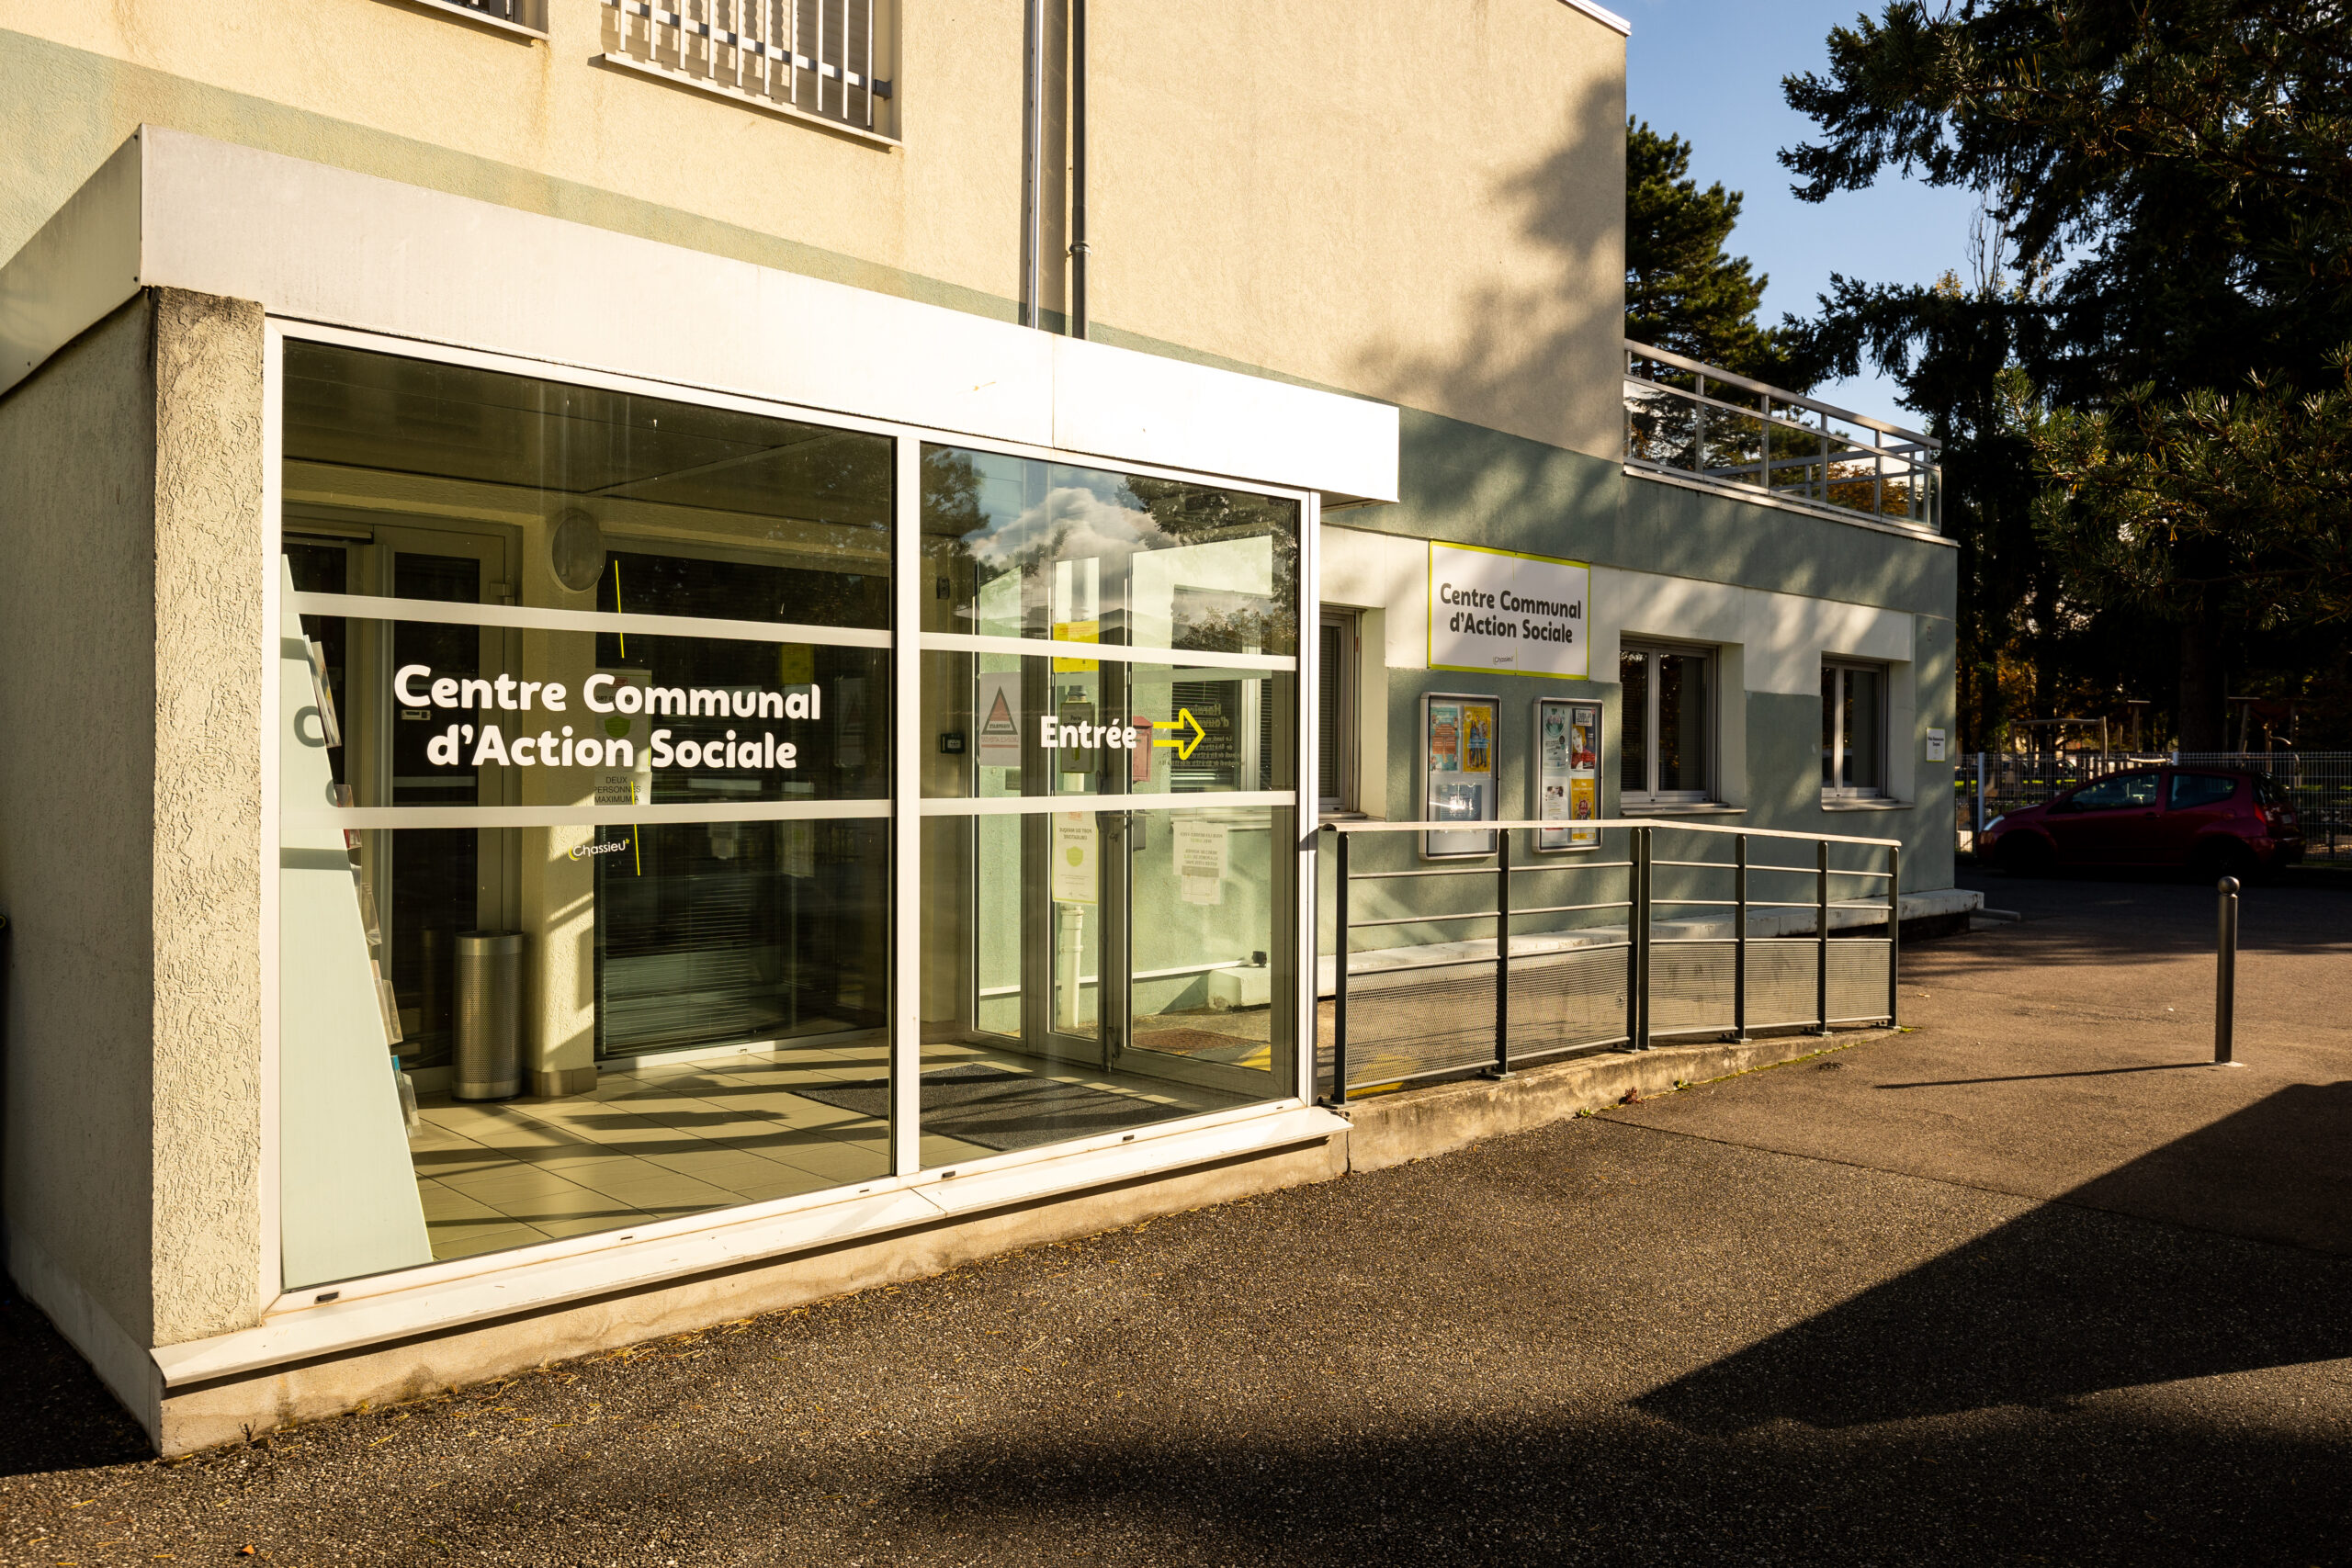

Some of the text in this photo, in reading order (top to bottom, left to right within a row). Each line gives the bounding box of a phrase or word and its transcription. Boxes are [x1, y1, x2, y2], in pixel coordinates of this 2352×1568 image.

[1441, 583, 1581, 620] Centre Communal
[1450, 613, 1573, 644] d'Action Sociale
[394, 664, 820, 719] Centre Communal
[1041, 716, 1137, 749] Entrée
[650, 730, 797, 769] Sociale
[605, 776, 628, 784] DEUX
[572, 840, 627, 858] Chassieu
